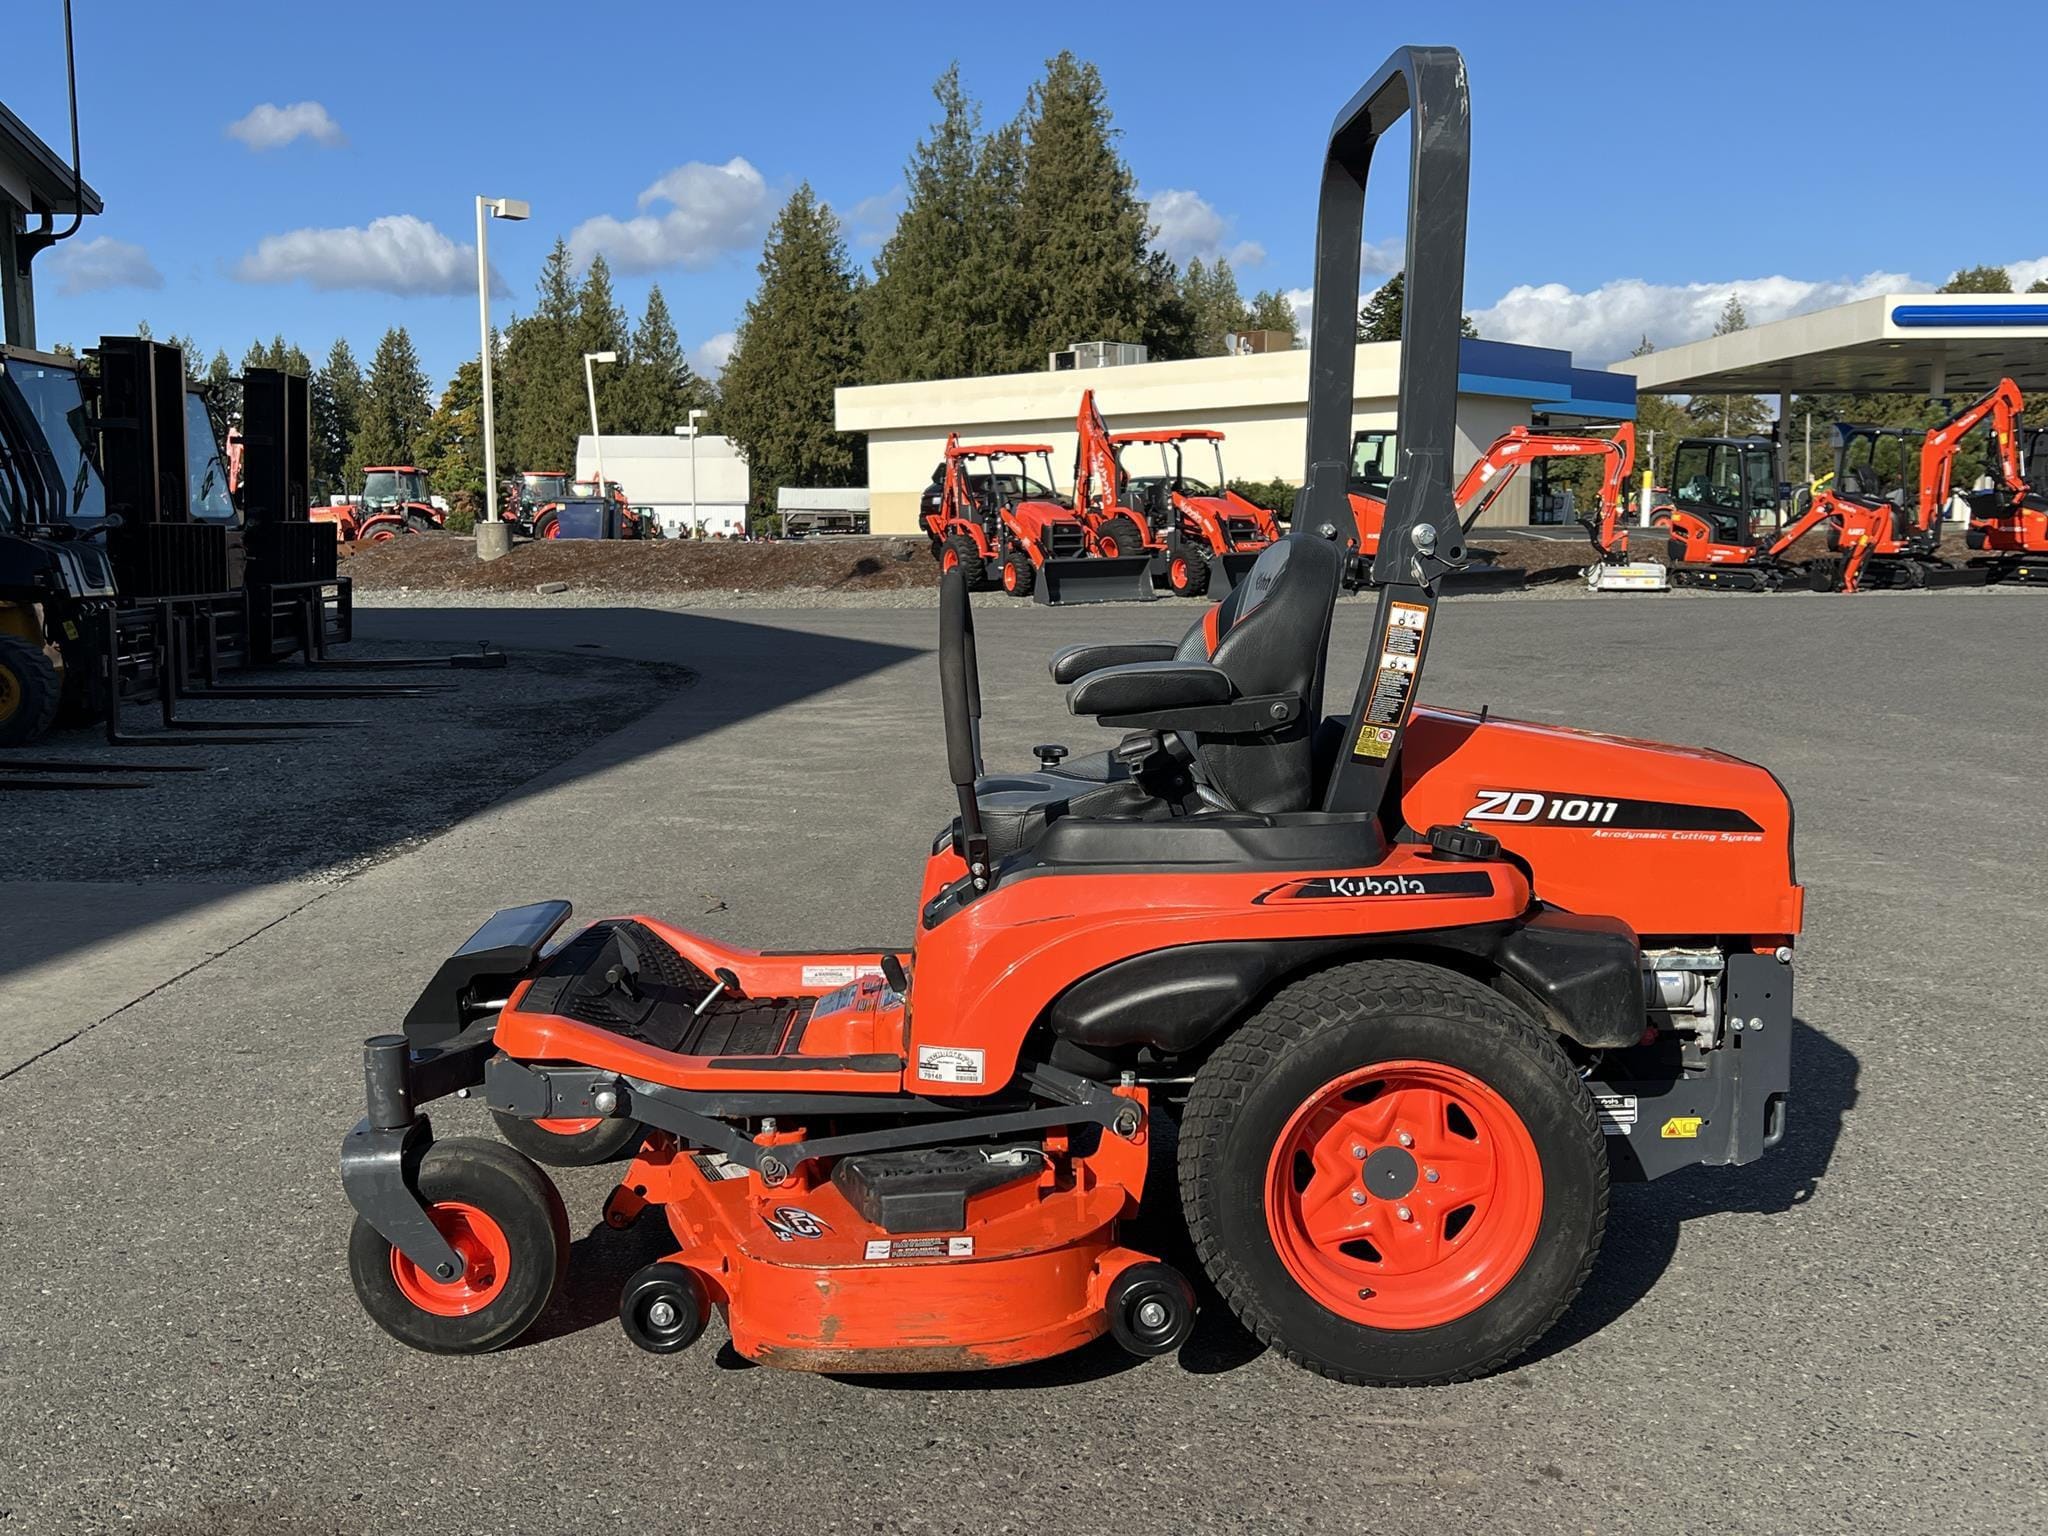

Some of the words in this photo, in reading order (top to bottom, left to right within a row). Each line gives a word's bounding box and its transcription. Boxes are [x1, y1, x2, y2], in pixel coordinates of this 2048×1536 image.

[1464, 790, 1546, 822] ZD
[1547, 799, 1618, 823] 1011
[1592, 829, 1667, 842] Aerodynamic
[1671, 831, 1717, 843] Cutting
[1719, 832, 1763, 843] System
[1329, 875, 1426, 897] Kubota
[783, 1211, 821, 1234] ACS
